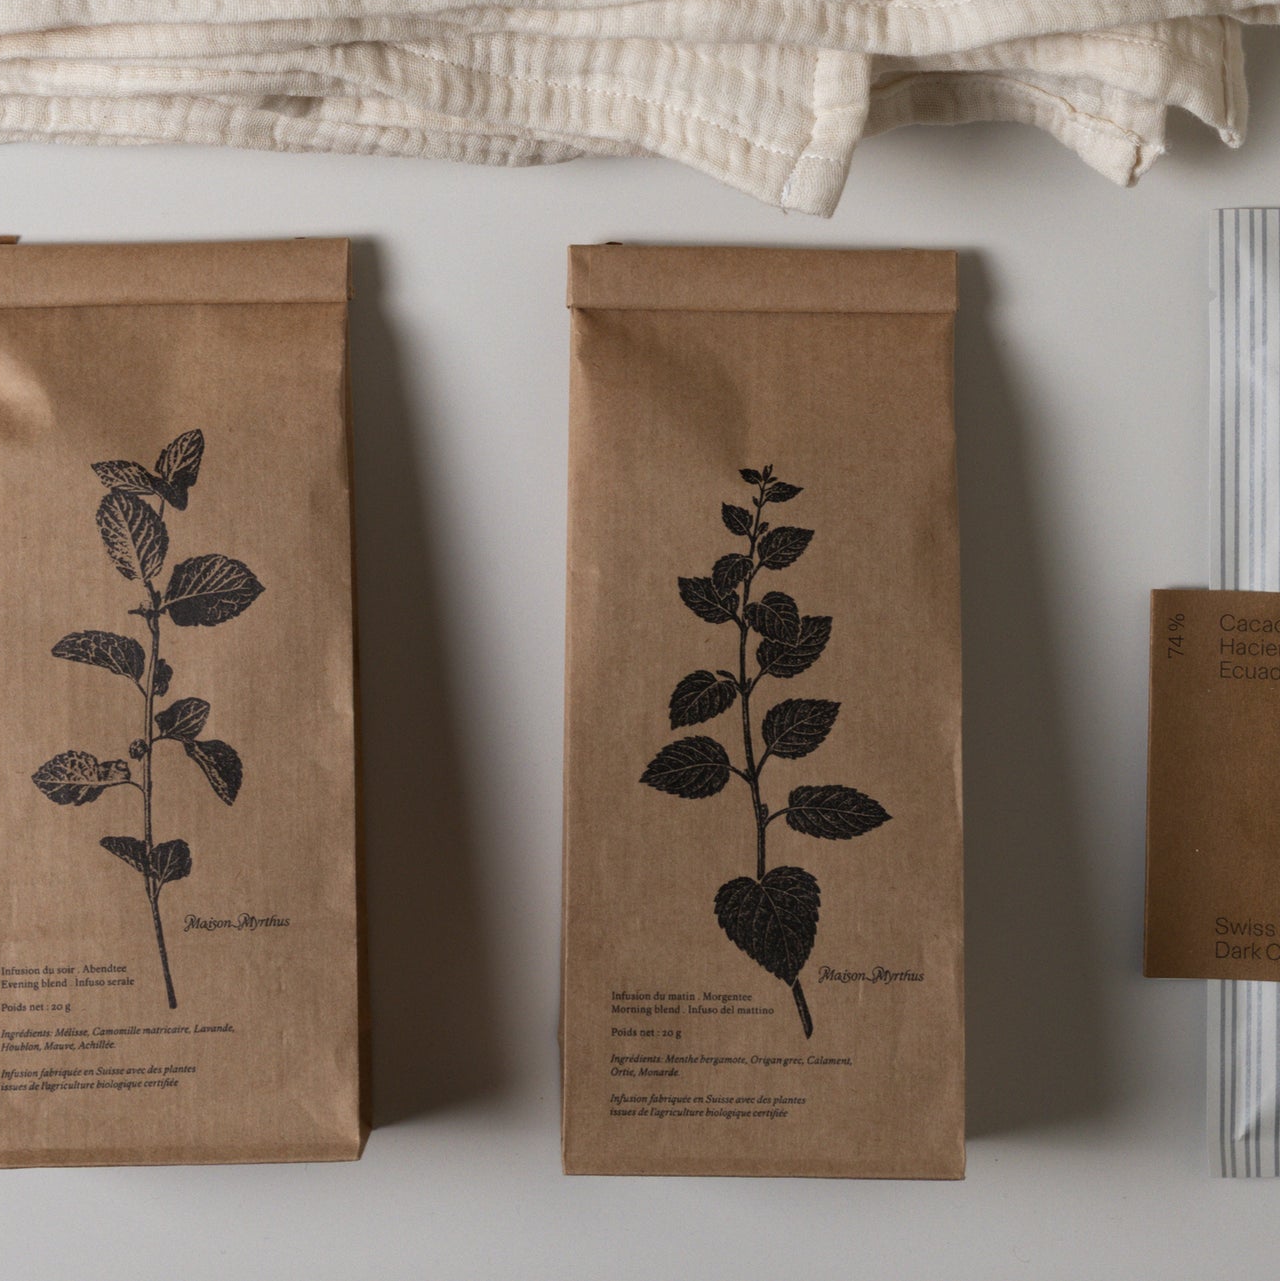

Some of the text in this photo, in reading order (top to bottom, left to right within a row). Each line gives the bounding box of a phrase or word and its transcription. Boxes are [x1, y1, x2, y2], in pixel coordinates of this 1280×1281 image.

[1167, 612, 1185, 659] 74 %
[183, 912, 291, 932] Maison Myrthus
[1214, 917, 1277, 939] Swiss
[1214, 941, 1262, 962] Dark
[1, 966, 41, 976] Infusion
[42, 965, 55, 975] du
[56, 965, 75, 975] soir
[82, 964, 127, 974] Abendtee
[818, 965, 925, 985] Maison Myrthus
[1, 980, 39, 991] Evening
[41, 978, 67, 988] blend
[75, 977, 105, 987] Infuso
[107, 976, 135, 986] serale
[611, 991, 651, 1001] Infusion
[653, 991, 666, 1001] du
[668, 991, 695, 1001] matin
[702, 992, 752, 1004] Morgentee
[1, 1002, 27, 1012] Poids
[29, 1003, 44, 1011] net
[51, 1003, 63, 1011] 20
[65, 1003, 71, 1013] g
[611, 1005, 652, 1016] Morning
[654, 1004, 680, 1014] blend
[688, 1004, 718, 1014] Infuso
[720, 1004, 735, 1015] del
[737, 1005, 775, 1015] mattino
[92, 1025, 142, 1036] Camomille
[611, 1027, 637, 1037] Poids
[640, 1028, 655, 1037] net
[662, 1029, 674, 1037] 20
[675, 1029, 682, 1039] g
[665, 1054, 699, 1064] Menthe
[750, 1055, 782, 1066] Origan
[0, 1068, 39, 1080] Infusion
[83, 1068, 94, 1076] en
[96, 1066, 125, 1076] Suisse
[126, 1067, 146, 1075] avec
[147, 1065, 162, 1074] des
[162, 1064, 196, 1076] plantes
[0, 1082, 27, 1091] issues
[28, 1080, 40, 1090] de
[96, 1077, 142, 1090] biologique
[610, 1094, 648, 1105] Infusion
[693, 1096, 704, 1104] en
[705, 1094, 734, 1104] Suisse
[735, 1096, 756, 1104] avec
[756, 1094, 772, 1105] des
[773, 1094, 807, 1106] plantes
[609, 1107, 636, 1117] issues
[638, 1107, 649, 1117] de
[705, 1107, 751, 1119] biologique
